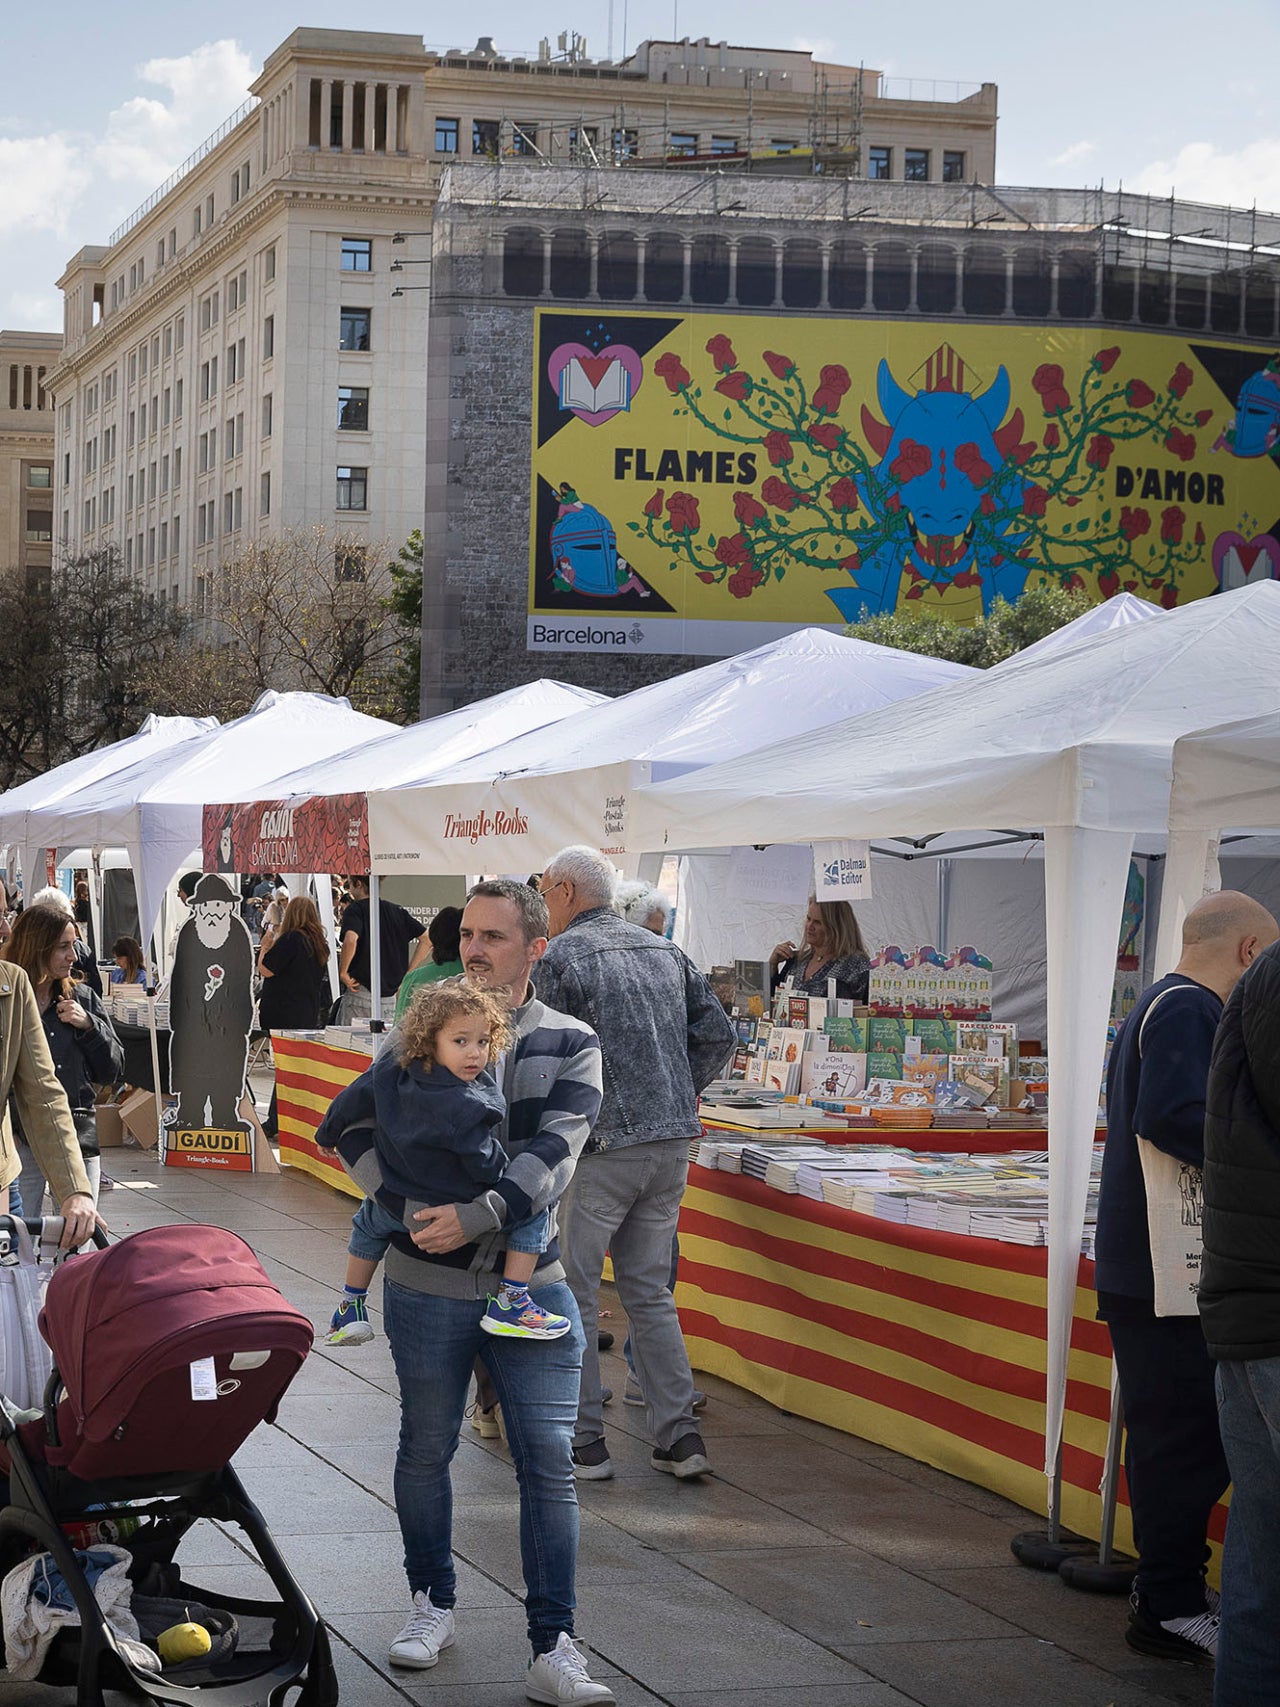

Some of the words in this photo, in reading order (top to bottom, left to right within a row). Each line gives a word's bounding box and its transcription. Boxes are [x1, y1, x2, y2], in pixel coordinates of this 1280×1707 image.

[614, 448, 757, 485] FLAMES
[1115, 465, 1225, 506] D'AMOR
[533, 624, 627, 645] Barcelona
[251, 839, 299, 866] BARCELONA
[840, 858, 867, 871] Dalmau
[841, 872, 863, 885] Editor
[180, 1132, 240, 1151] GAUDÍ
